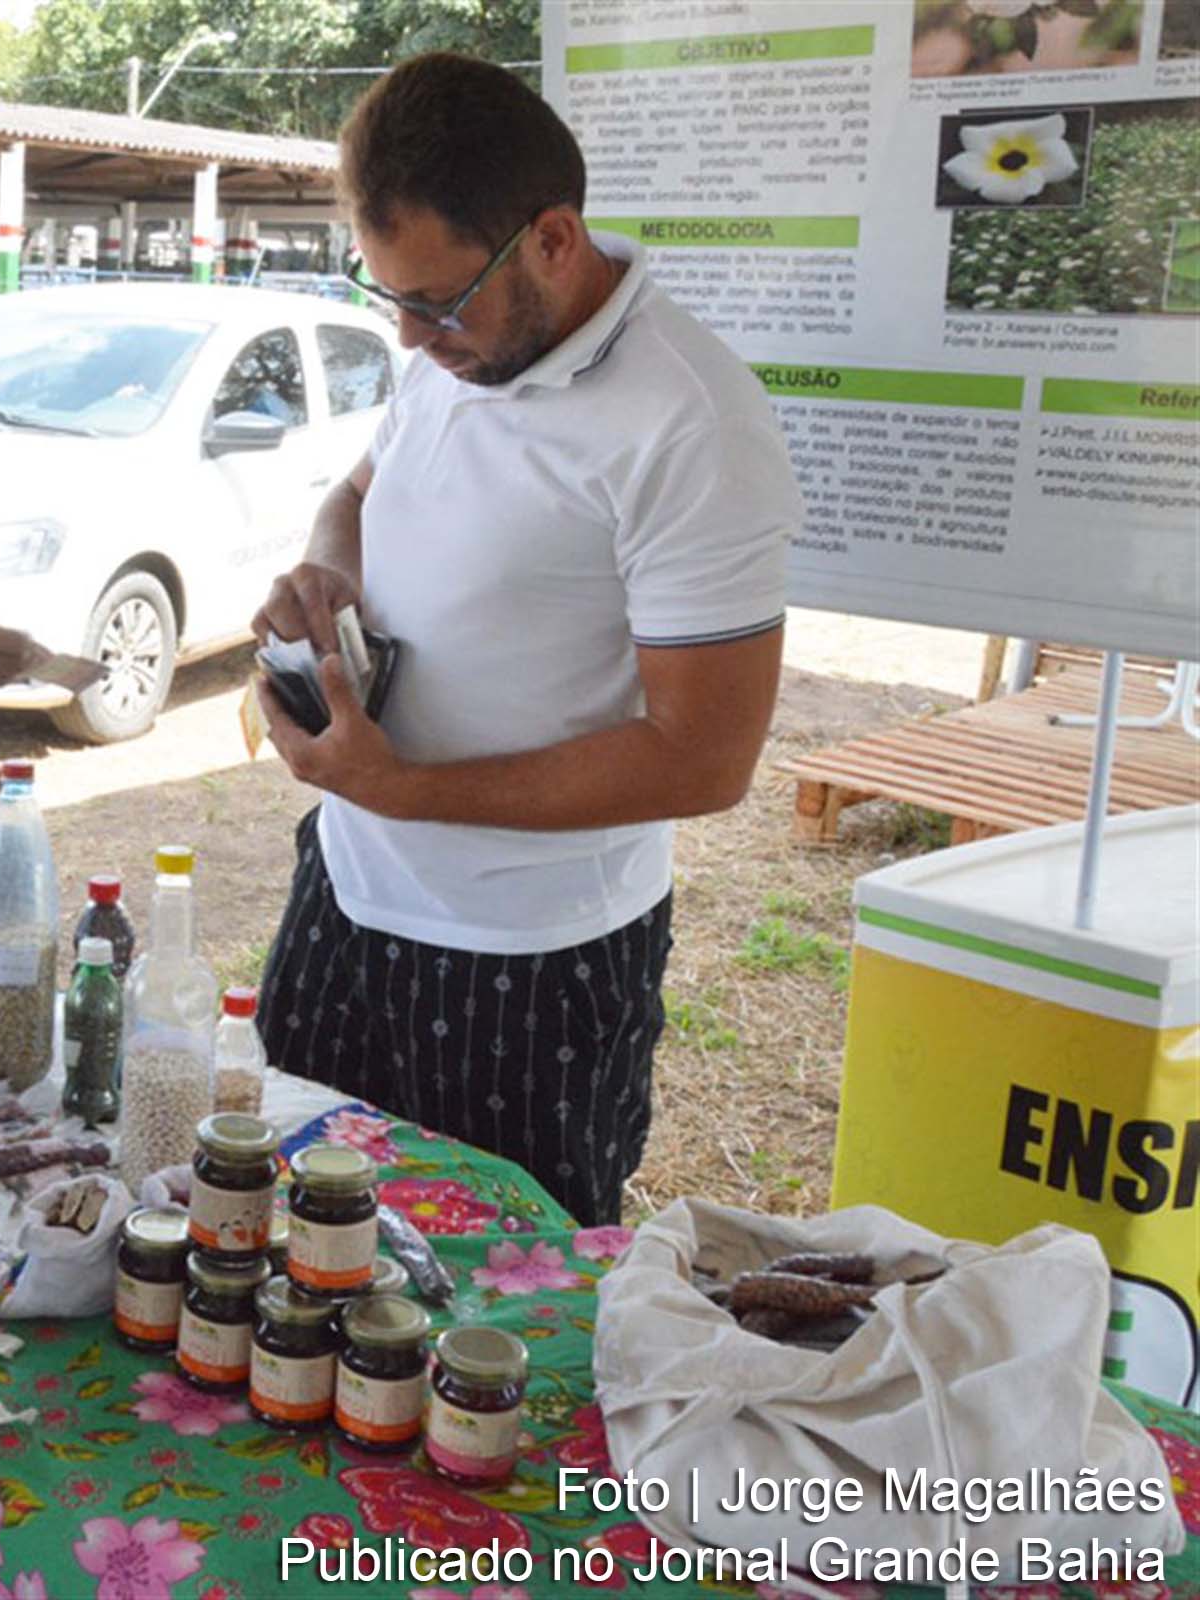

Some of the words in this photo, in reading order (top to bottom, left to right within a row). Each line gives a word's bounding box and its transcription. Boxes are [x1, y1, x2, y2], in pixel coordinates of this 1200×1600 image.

[677, 38, 771, 61] OBJETIVO
[761, 138, 787, 150] uma
[798, 135, 840, 149] cultura
[852, 134, 867, 147] de
[641, 222, 775, 239] METODOLOGIA
[835, 272, 856, 283] em
[757, 303, 836, 318] comunidades
[782, 405, 807, 417] uma
[811, 407, 887, 422] necessidade
[892, 411, 907, 423] de
[912, 413, 968, 429] expandir
[986, 418, 1020, 431] tema
[809, 423, 831, 435] das
[844, 425, 889, 440] plantas
[992, 434, 1019, 448] não
[849, 442, 903, 458] produtos
[907, 446, 950, 460] conter
[1048, 445, 1114, 462] VALDELY
[936, 466, 952, 479] de
[965, 470, 1014, 484] valores
[840, 476, 911, 493] valorização
[919, 481, 944, 496] dos
[954, 485, 1012, 502] produtos
[954, 502, 1010, 518] estadual
[842, 507, 919, 527] fortalecendo
[939, 518, 1008, 537] agricultura
[852, 527, 887, 541] sobre
[912, 533, 1005, 554] biodiversidade
